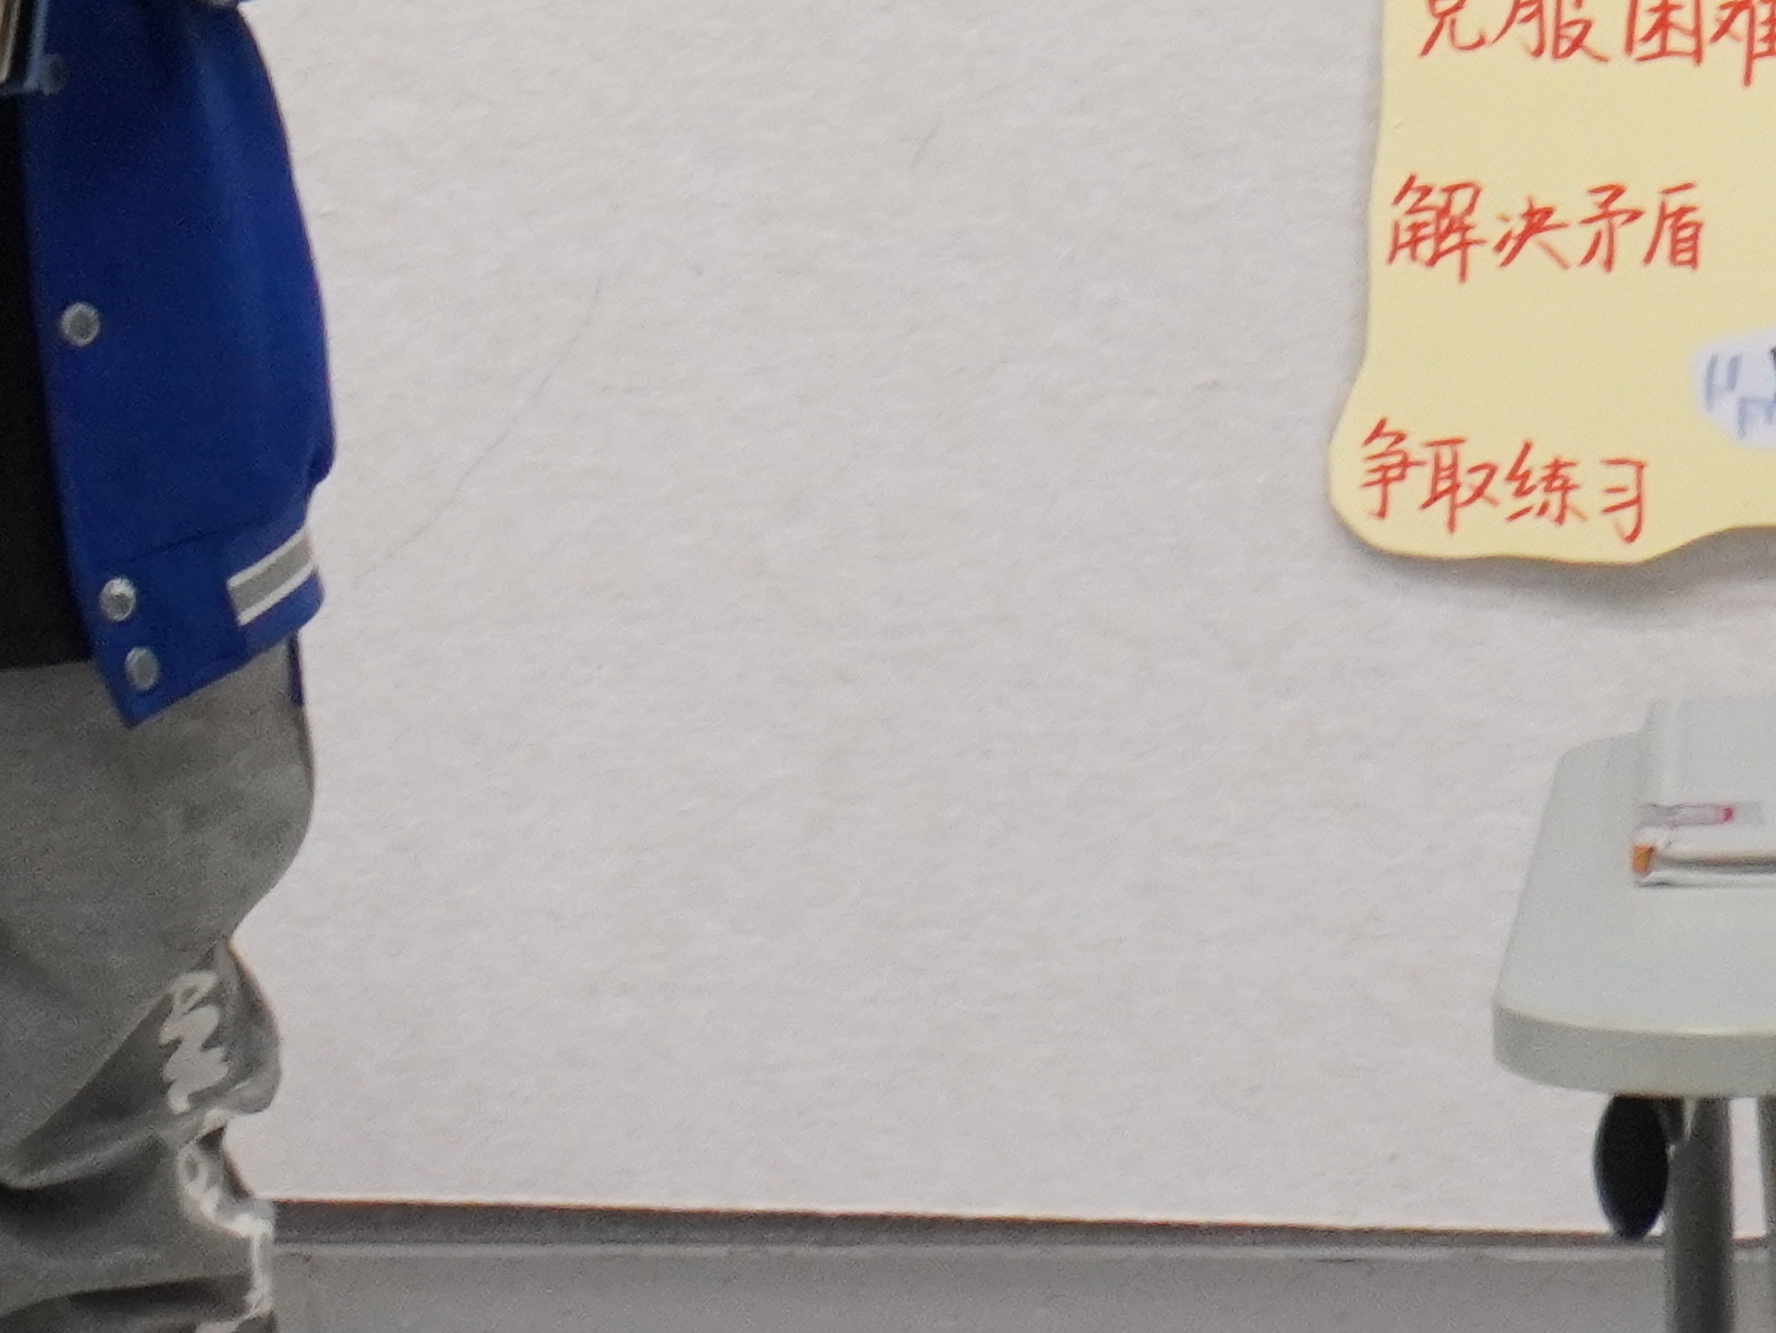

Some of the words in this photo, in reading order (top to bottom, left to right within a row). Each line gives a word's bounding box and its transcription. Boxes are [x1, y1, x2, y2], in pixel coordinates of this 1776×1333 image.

[1386, 173, 1705, 285] 解决矛盾
[1359, 416, 1650, 544] 争取练习
